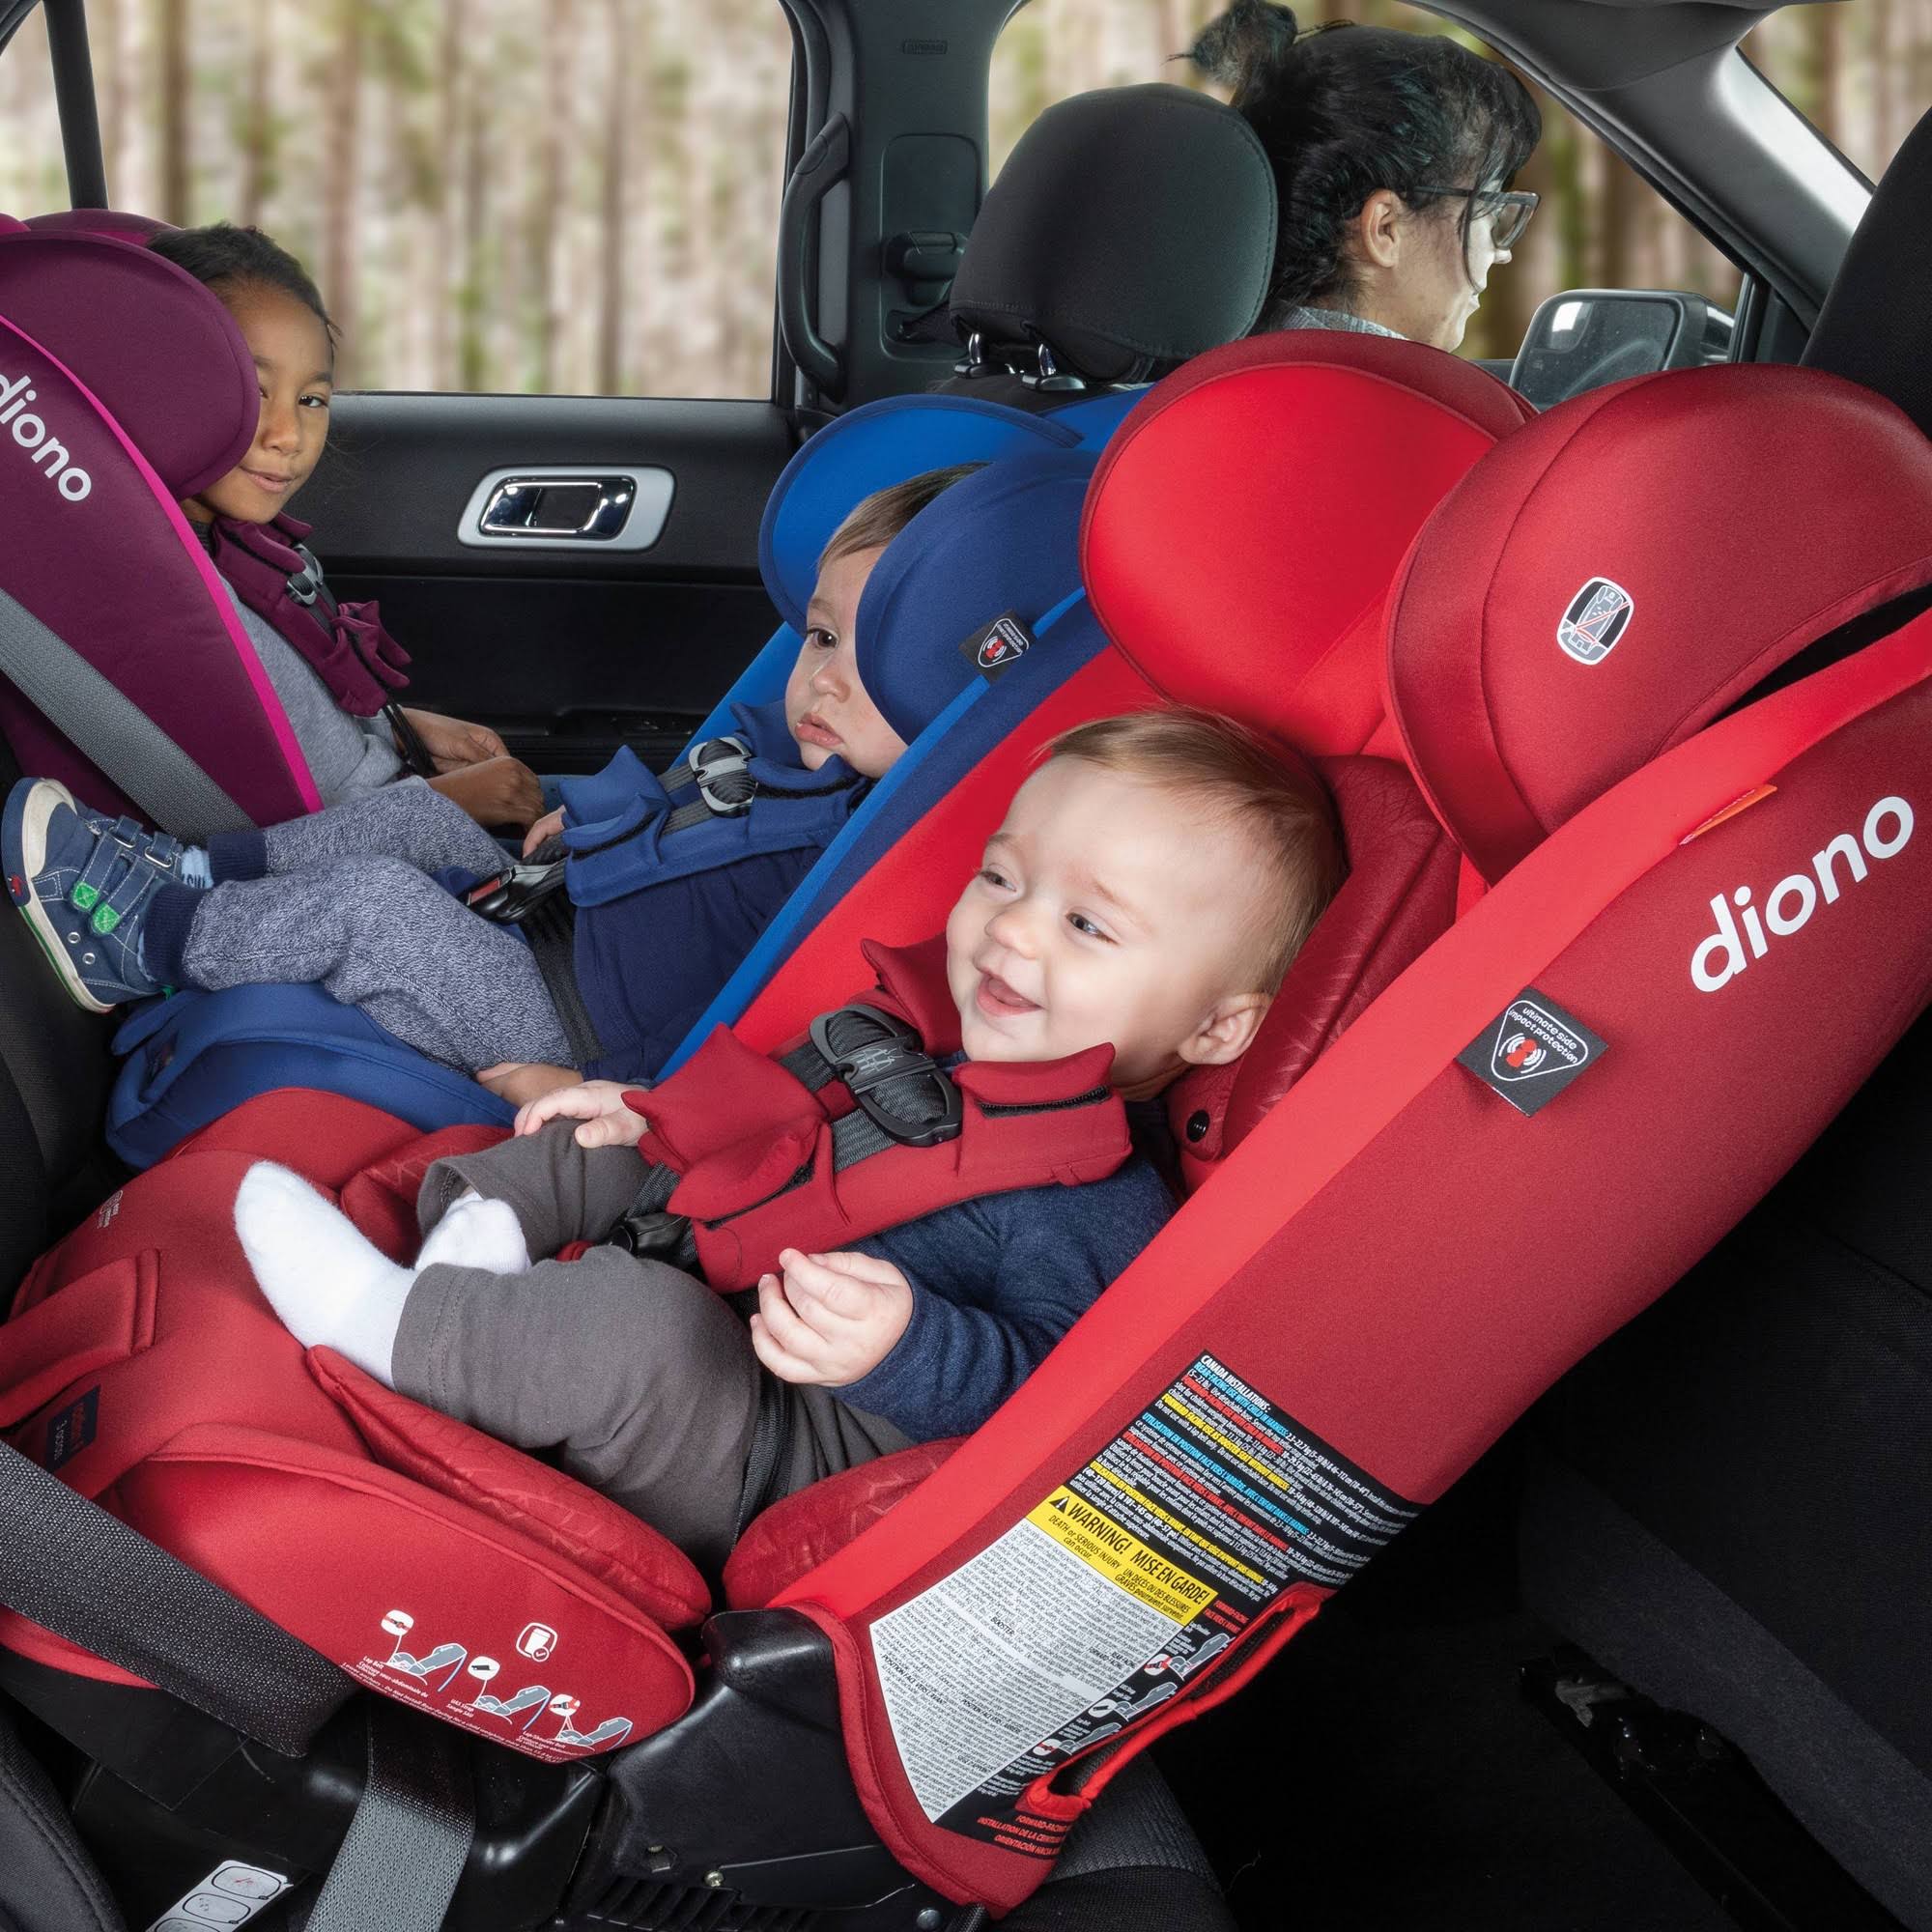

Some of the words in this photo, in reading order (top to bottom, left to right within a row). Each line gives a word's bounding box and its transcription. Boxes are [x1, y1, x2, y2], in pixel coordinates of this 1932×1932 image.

[0, 374, 92, 501] diono
[1690, 796, 1914, 993] diono
[1509, 1009, 1536, 1031] impact
[1534, 1028, 1578, 1064] protection
[1522, 1007, 1558, 1035] ultimate
[1557, 1031, 1577, 1050] side
[1198, 1353, 1230, 1378] CANADA
[1049, 1515, 1069, 1531] DEATH
[1075, 1535, 1100, 1554] SERIOUS
[1099, 1552, 1120, 1569] INJURY
[1064, 1538, 1075, 1547] can
[1074, 1546, 1092, 1558] occur.
[1067, 1503, 1133, 1554] WARNING!
[1130, 1549, 1163, 1576] MISE
[1155, 1567, 1178, 1584] EN
[1171, 1577, 1210, 1605] GARDE!
[1115, 1575, 1137, 1591] GRAVES
[1133, 1588, 1164, 1607] pourraient
[1123, 1569, 1134, 1578] UN
[1154, 1589, 1166, 1599] DES
[1163, 1594, 1191, 1613] BLESSURES
